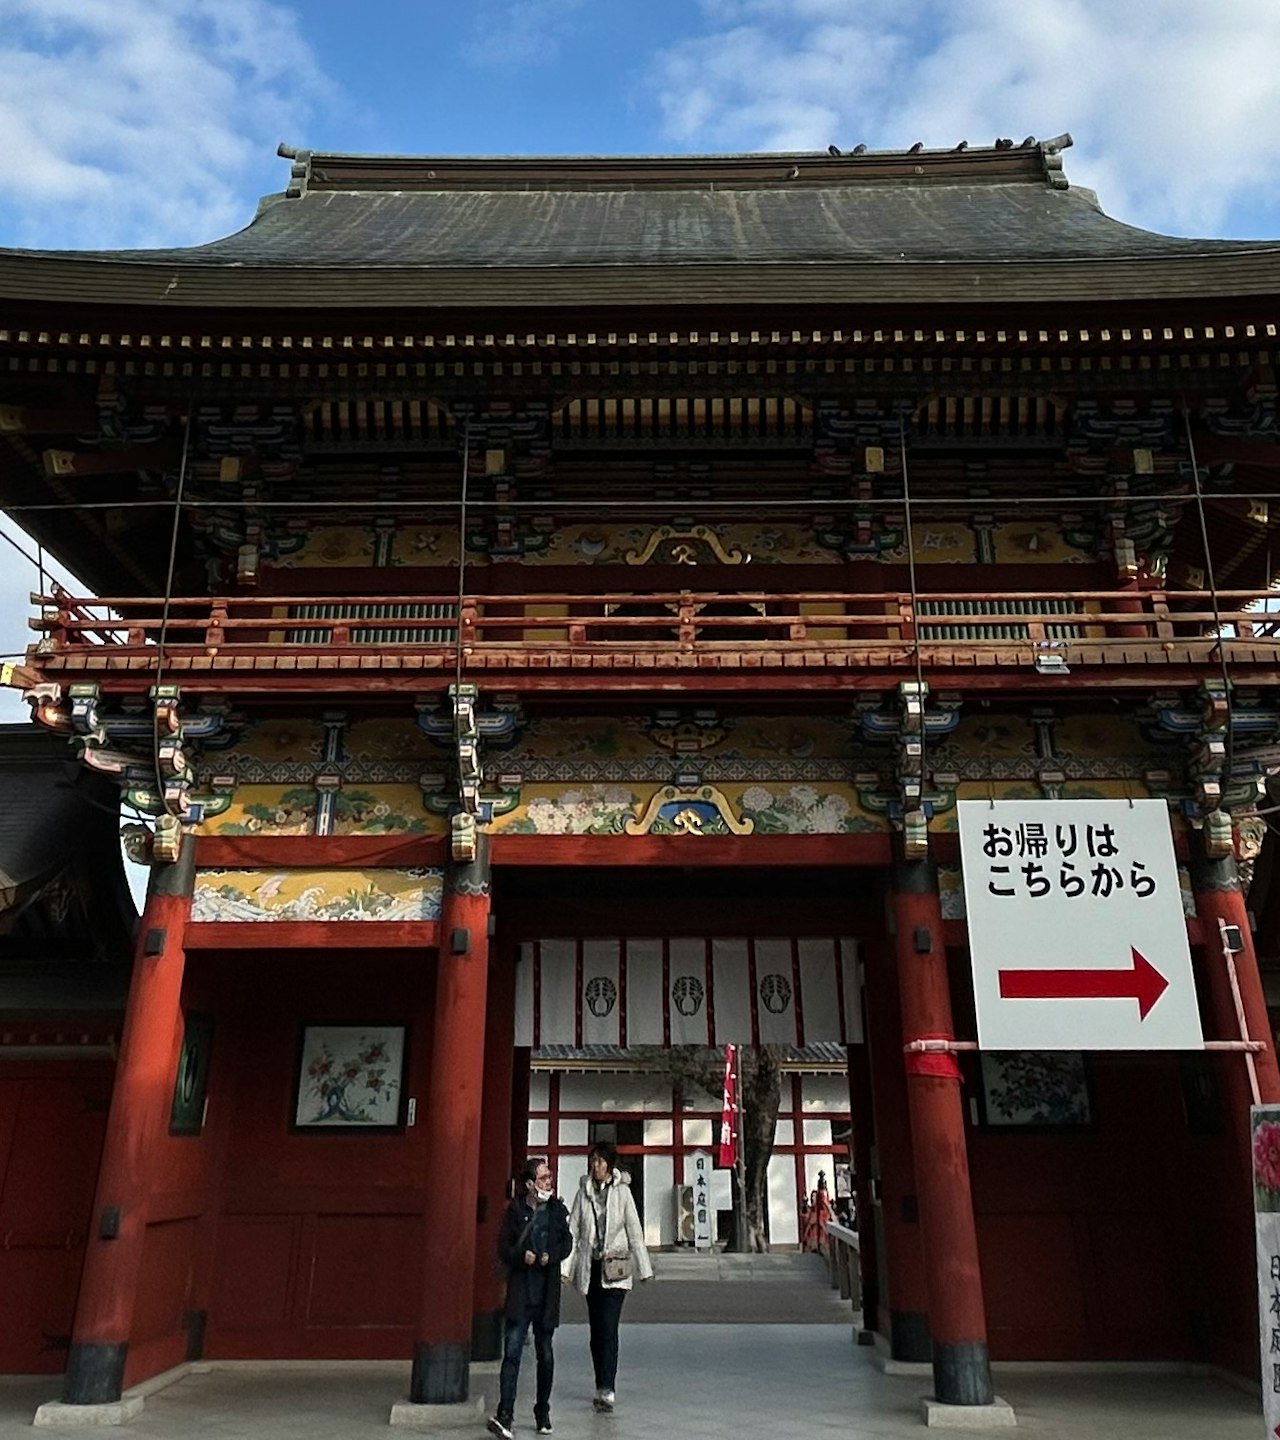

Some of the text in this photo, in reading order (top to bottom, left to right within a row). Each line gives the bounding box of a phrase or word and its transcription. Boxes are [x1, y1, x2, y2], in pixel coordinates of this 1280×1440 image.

[983, 823, 1119, 858] お帰りは
[988, 861, 1156, 898] こちらから
